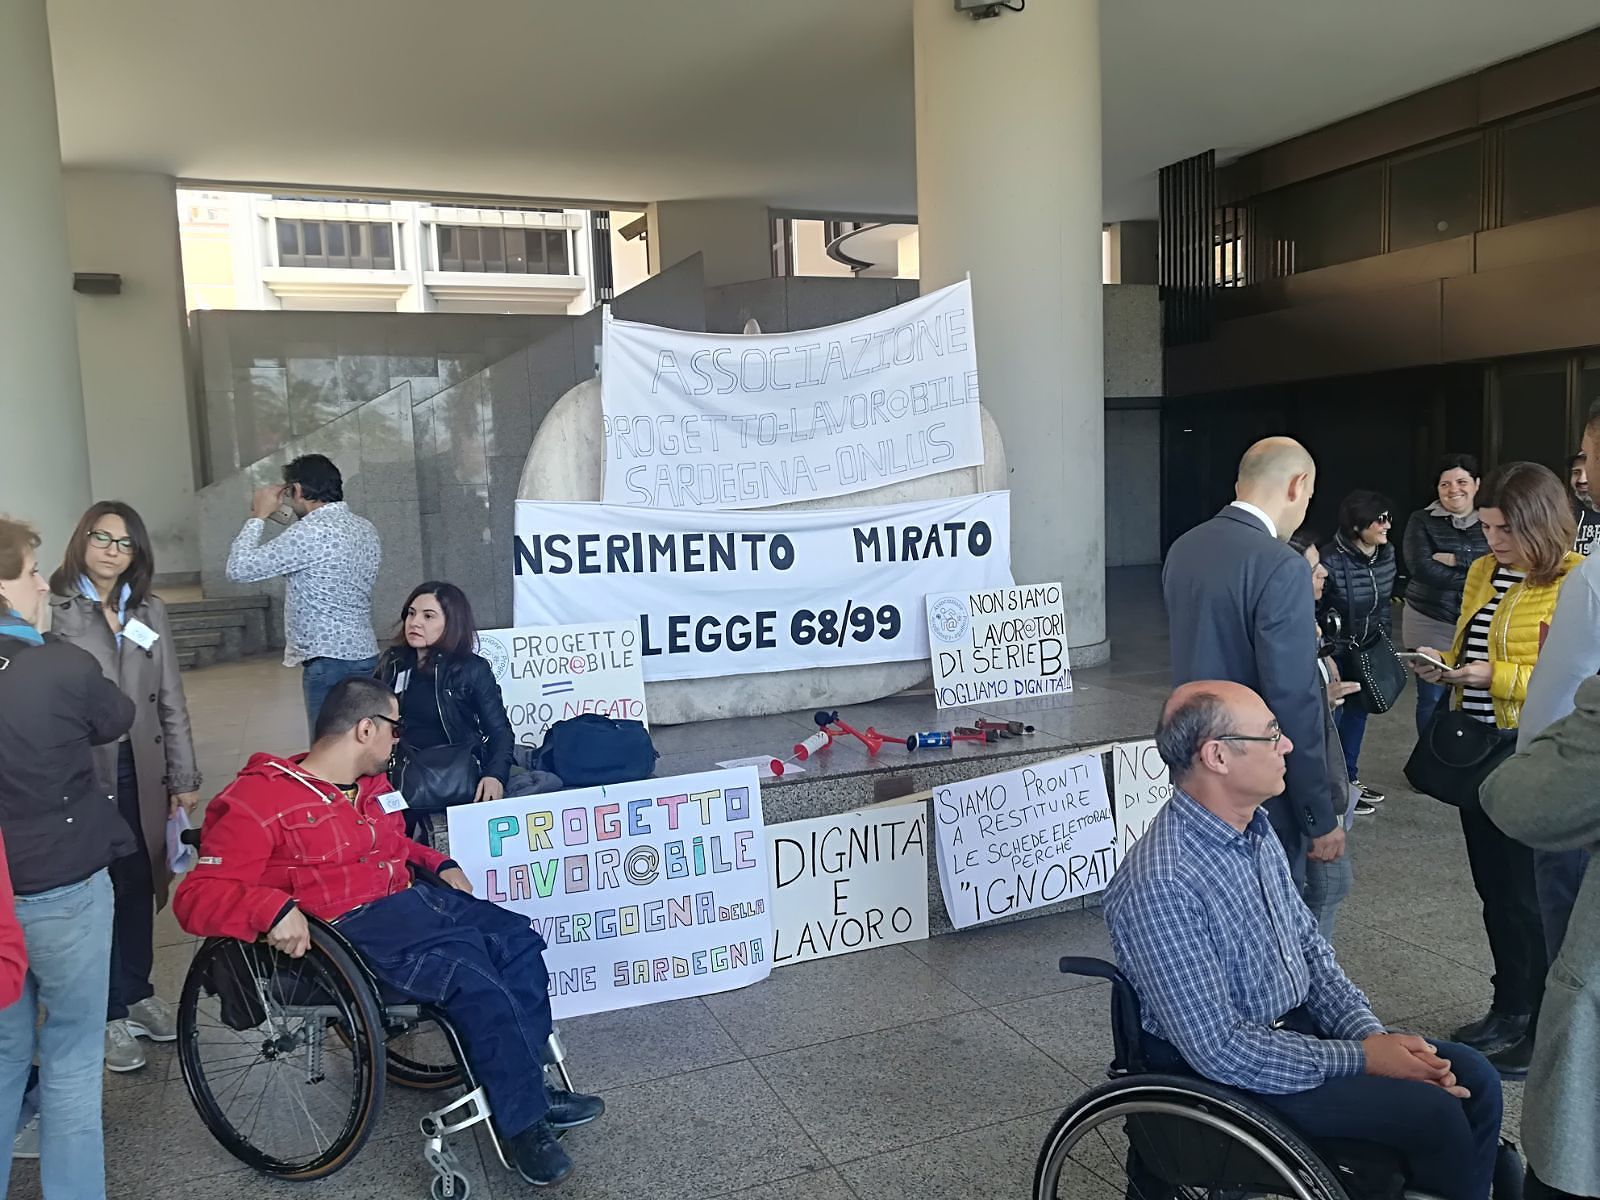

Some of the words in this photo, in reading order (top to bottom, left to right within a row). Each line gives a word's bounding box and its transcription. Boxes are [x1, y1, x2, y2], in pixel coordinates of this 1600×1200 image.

[652, 308, 967, 396] ASSOCIAZIONE
[626, 421, 955, 507] SARDEGNA-ONLUS
[853, 520, 992, 562] MIRATO
[970, 589, 1004, 616] NON
[1008, 586, 1060, 610] SIAMO
[513, 630, 635, 658] PROGETTO
[640, 611, 777, 656] LEGGE
[790, 599, 902, 648] 68/99
[972, 613, 1064, 649] LAVOR@TORI
[511, 650, 634, 679] LAVOR@BILE
[940, 649, 965, 678] DI
[973, 643, 1037, 674] SERIE
[1038, 638, 1063, 676] B
[935, 680, 1008, 707] VOGLIAMO
[937, 784, 1007, 825] SIAMO
[1022, 764, 1089, 801] PRONTI
[953, 826, 963, 847] A
[978, 790, 1090, 838] RESTITUIRE
[488, 786, 750, 857] PROGETTO
[953, 849, 979, 875] LE
[987, 829, 1049, 864] SCHEDE
[532, 891, 716, 945] VERGOGNA
[718, 898, 765, 922] DELLA
[834, 879, 850, 916] E
[773, 907, 912, 962] LAVORO
[614, 937, 764, 987] SARDEGNA
